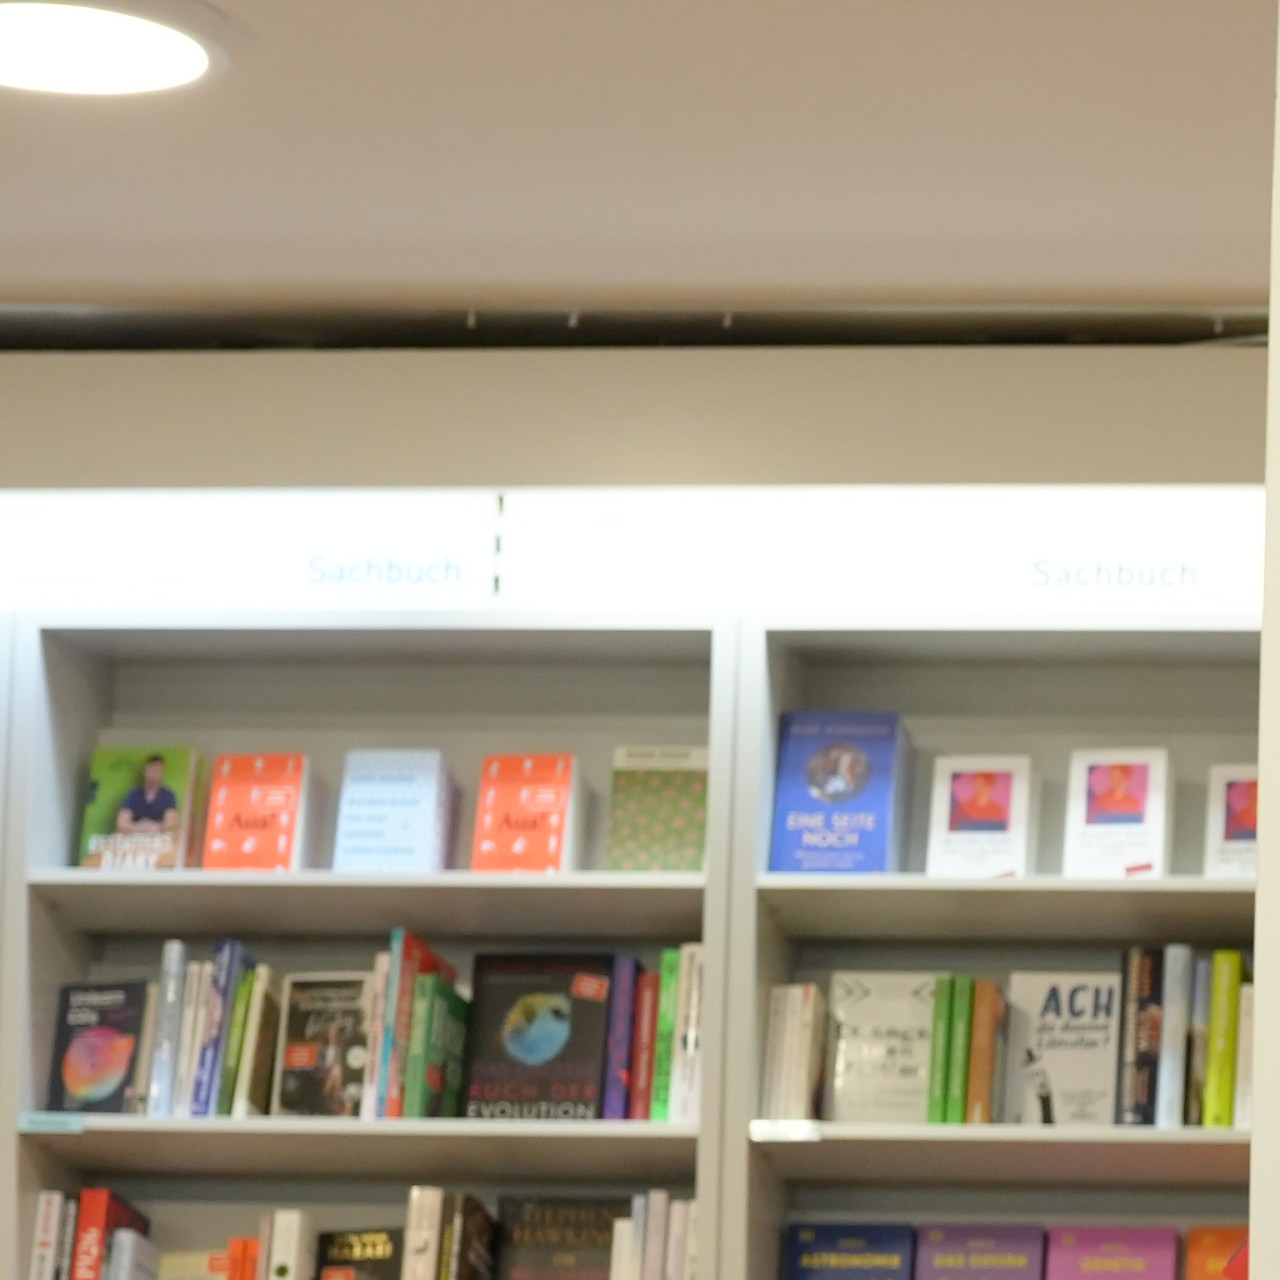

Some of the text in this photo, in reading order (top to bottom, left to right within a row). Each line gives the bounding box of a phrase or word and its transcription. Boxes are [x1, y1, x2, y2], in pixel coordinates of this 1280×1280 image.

[308, 555, 463, 586] Sachbuch
[1032, 558, 1199, 587] Sachbuch
[1041, 982, 1115, 1018] ACH
[466, 1100, 597, 1119] EVOLUTION
